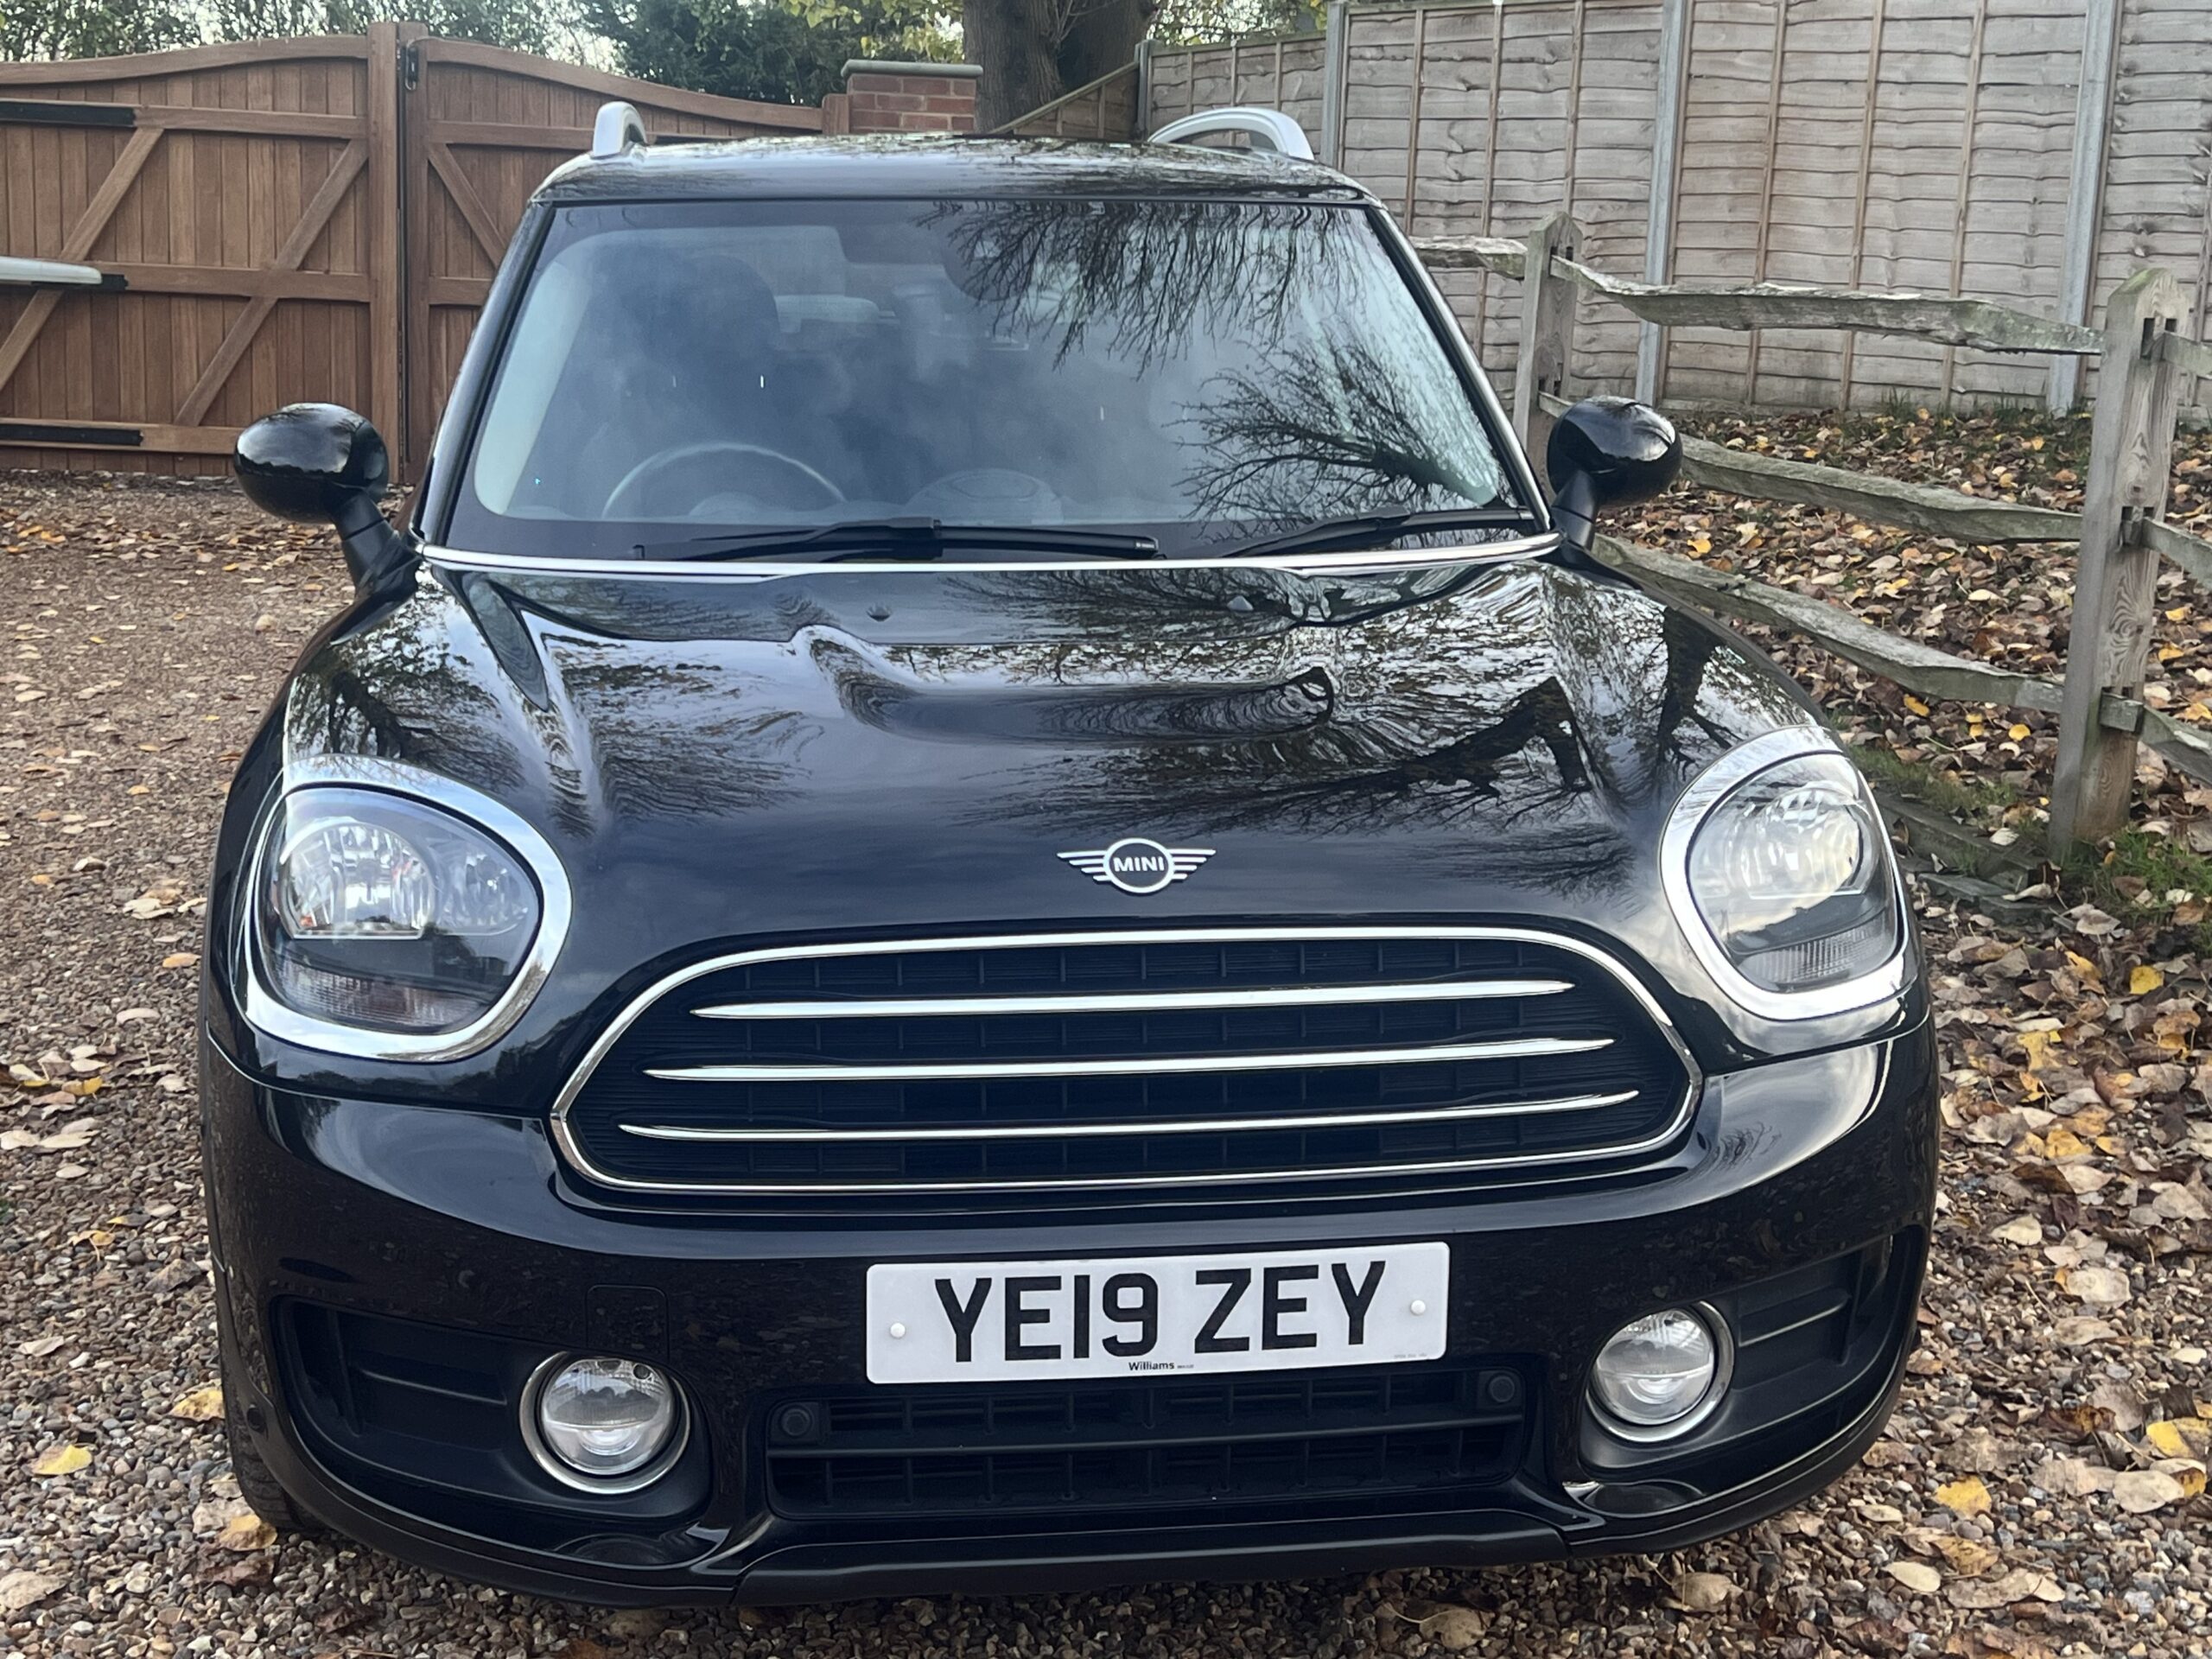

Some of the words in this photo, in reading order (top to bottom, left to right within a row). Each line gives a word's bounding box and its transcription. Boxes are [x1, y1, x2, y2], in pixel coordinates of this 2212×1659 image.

[1114, 856, 1165, 872] MINI
[934, 1273, 1158, 1362] YE19
[1194, 1261, 1386, 1354] ZEY
[1128, 1361, 1174, 1371] Williams
